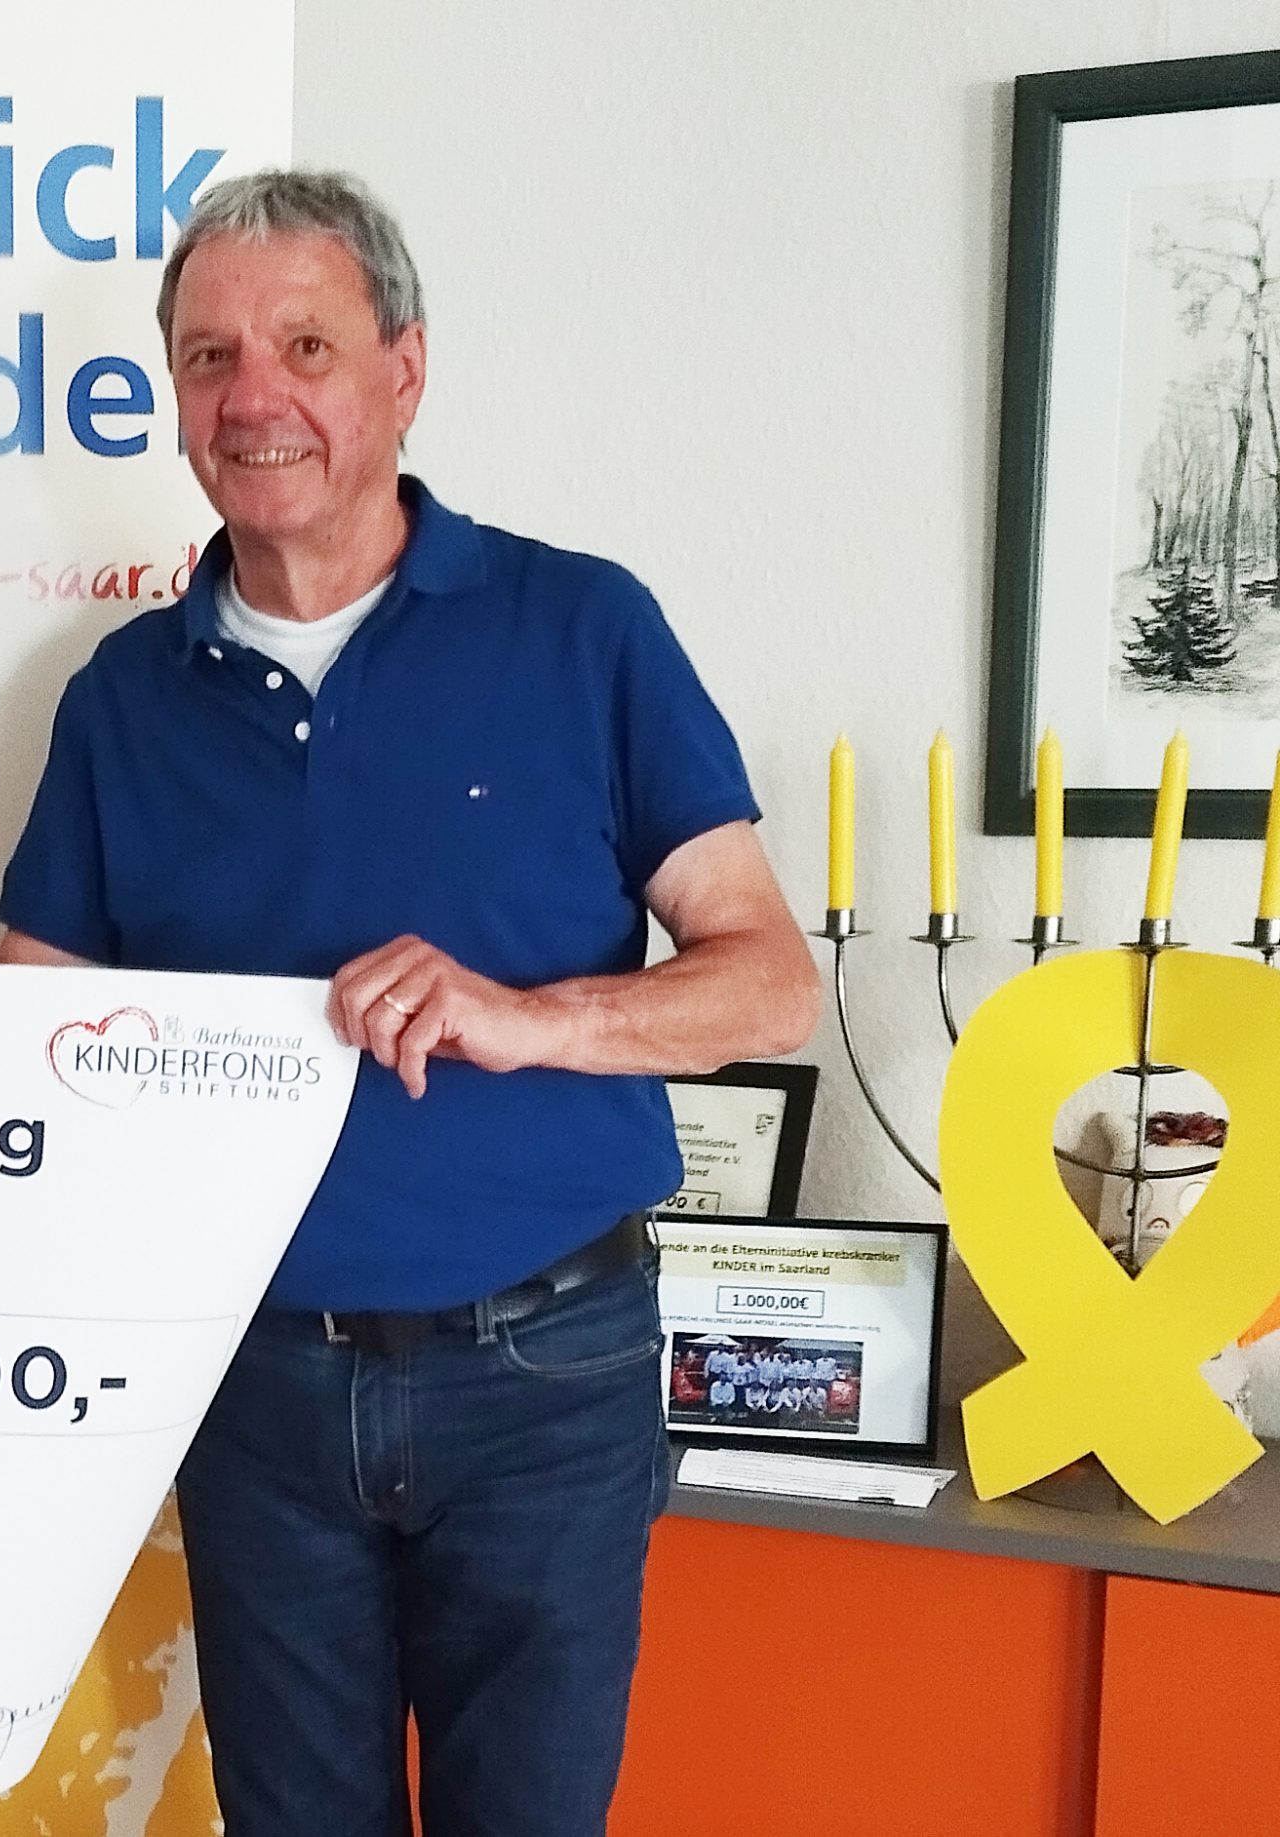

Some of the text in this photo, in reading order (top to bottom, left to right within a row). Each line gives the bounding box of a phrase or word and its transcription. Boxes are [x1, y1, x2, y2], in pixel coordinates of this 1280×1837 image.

[192, 1026, 304, 1050] Barbarossa
[75, 1044, 322, 1084] KINDERFONDS
[159, 1080, 301, 1102] STIFTUNG
[660, 1241, 689, 1253] ende
[712, 1259, 757, 1272] KINDER
[778, 1263, 831, 1276] Saarland
[731, 1292, 810, 1312] 1.000,00€
